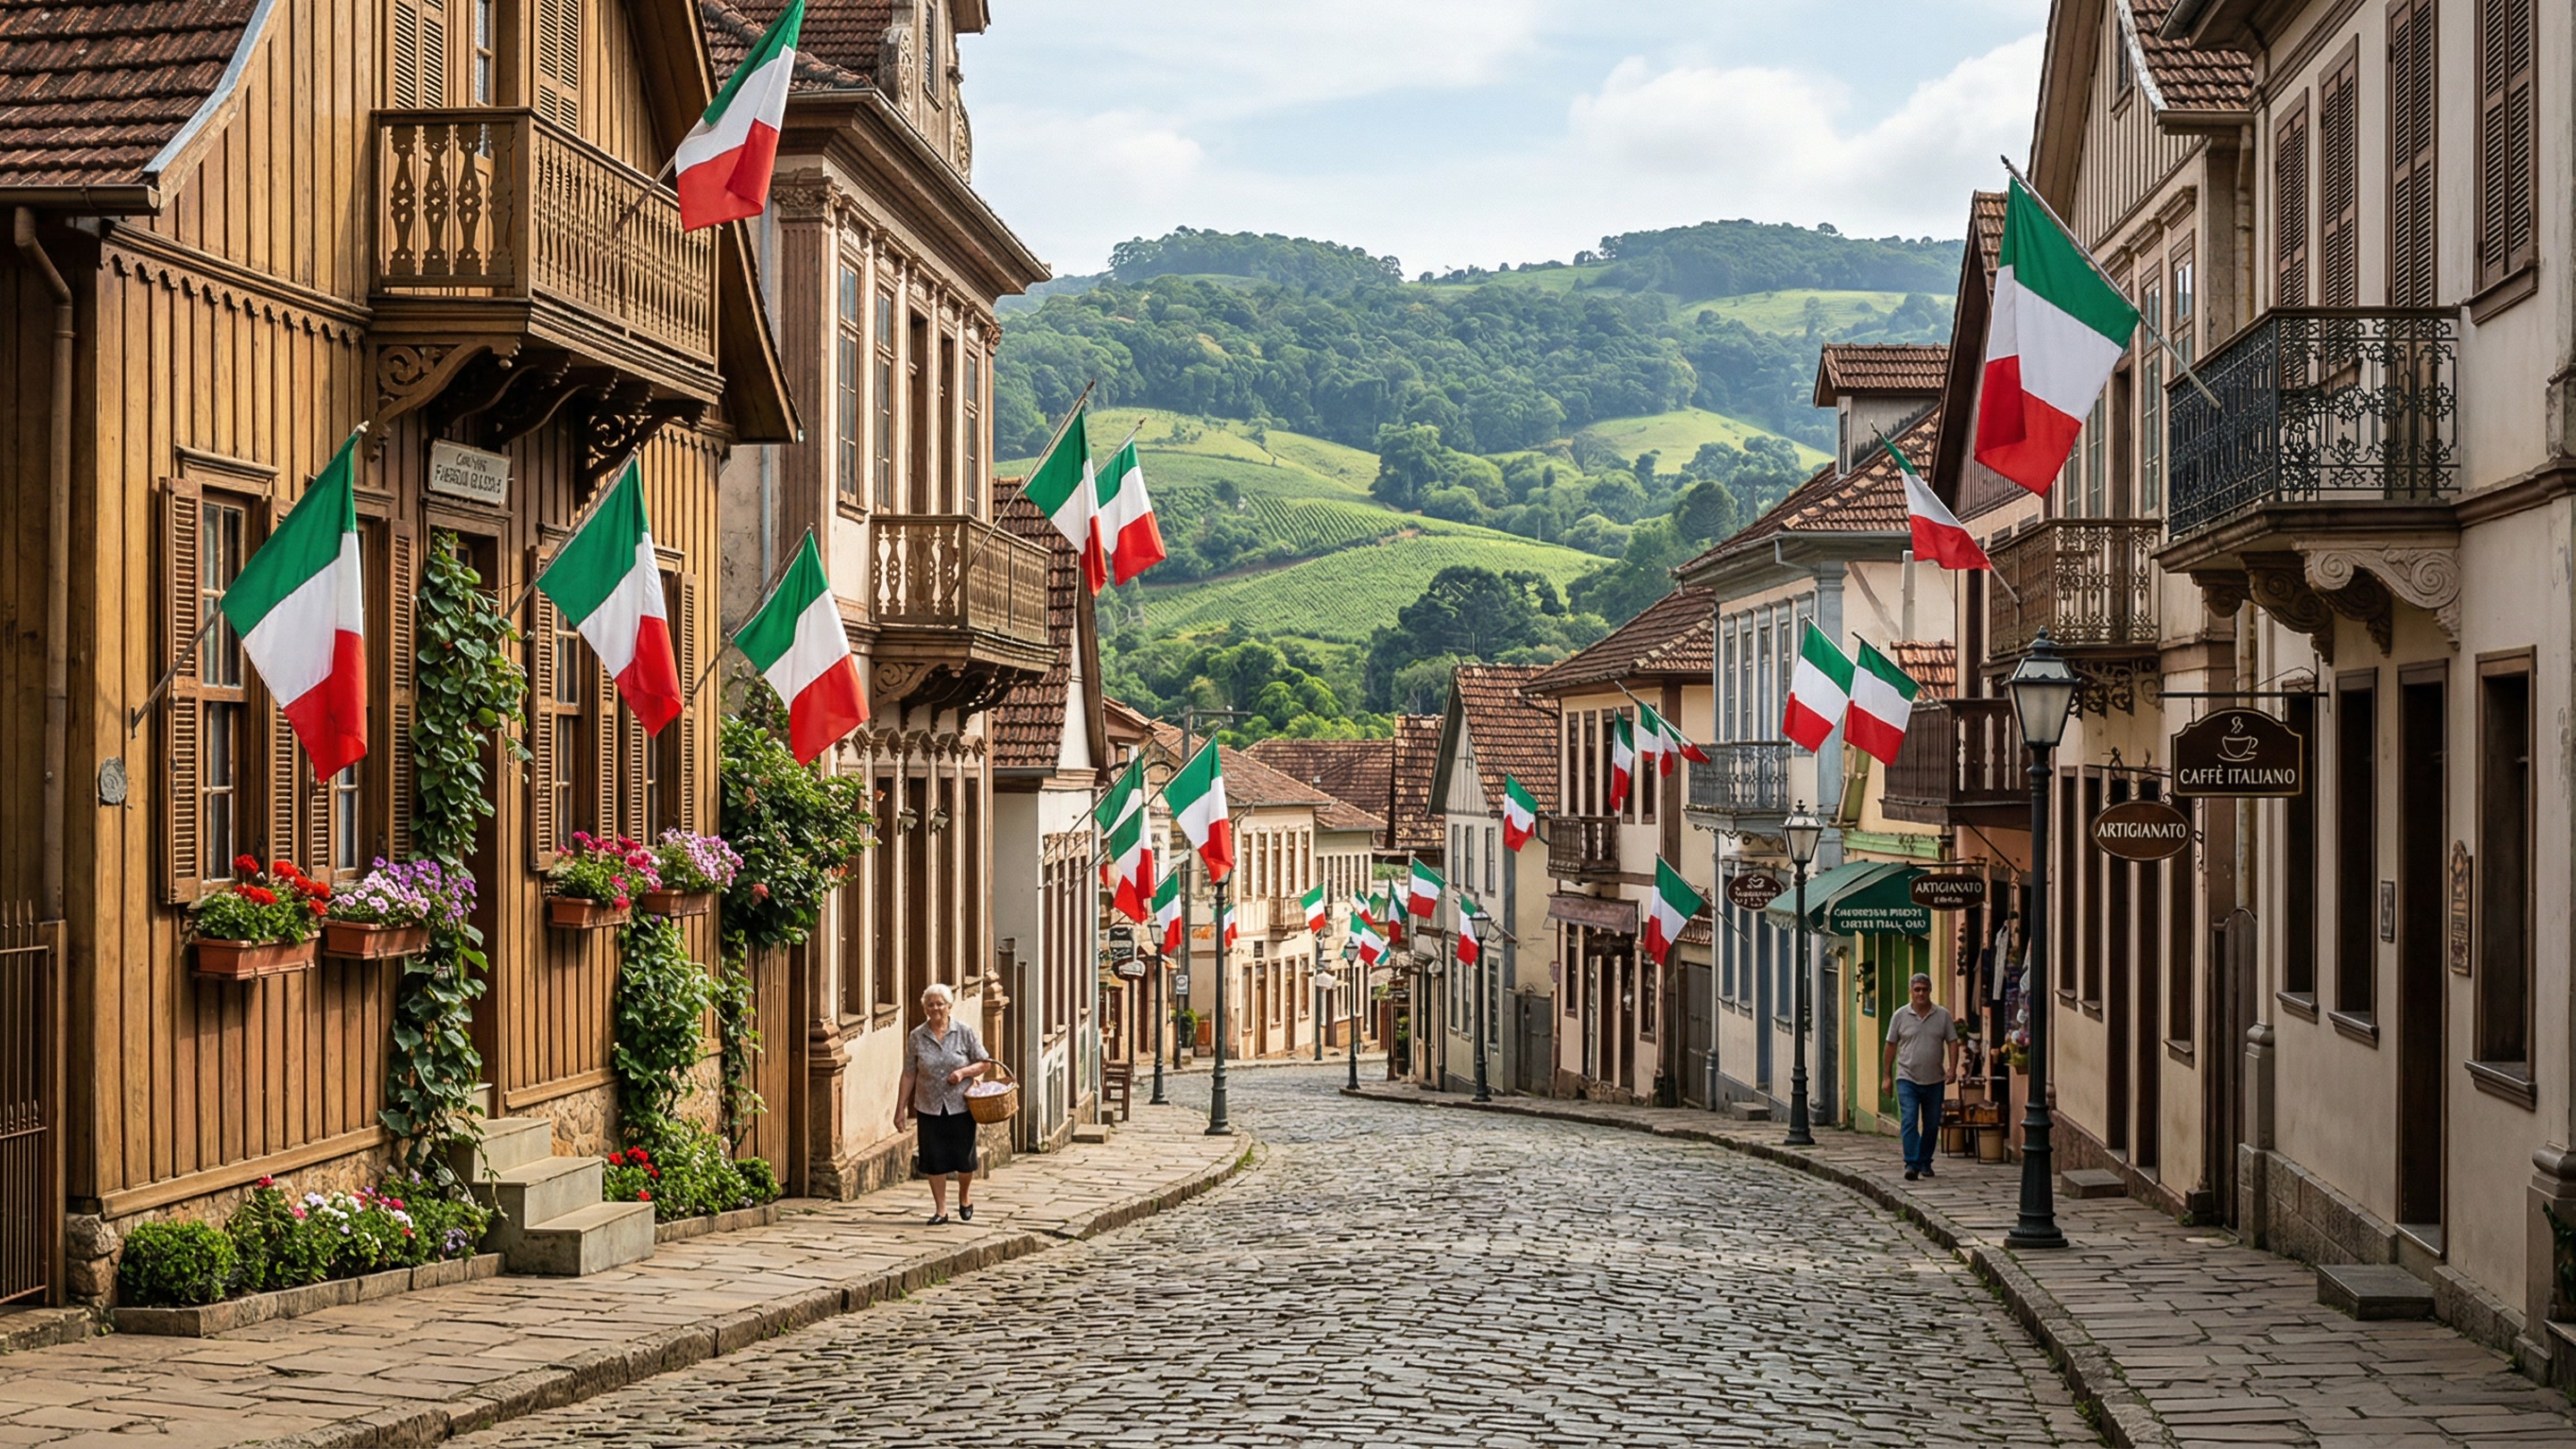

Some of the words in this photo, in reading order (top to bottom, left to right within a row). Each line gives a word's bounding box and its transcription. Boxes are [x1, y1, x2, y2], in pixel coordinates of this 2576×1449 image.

[2180, 765, 2224, 784] CAFFÈ
[2228, 768, 2295, 784] ITALIANO
[2097, 822, 2186, 838] ARTIGIANATO
